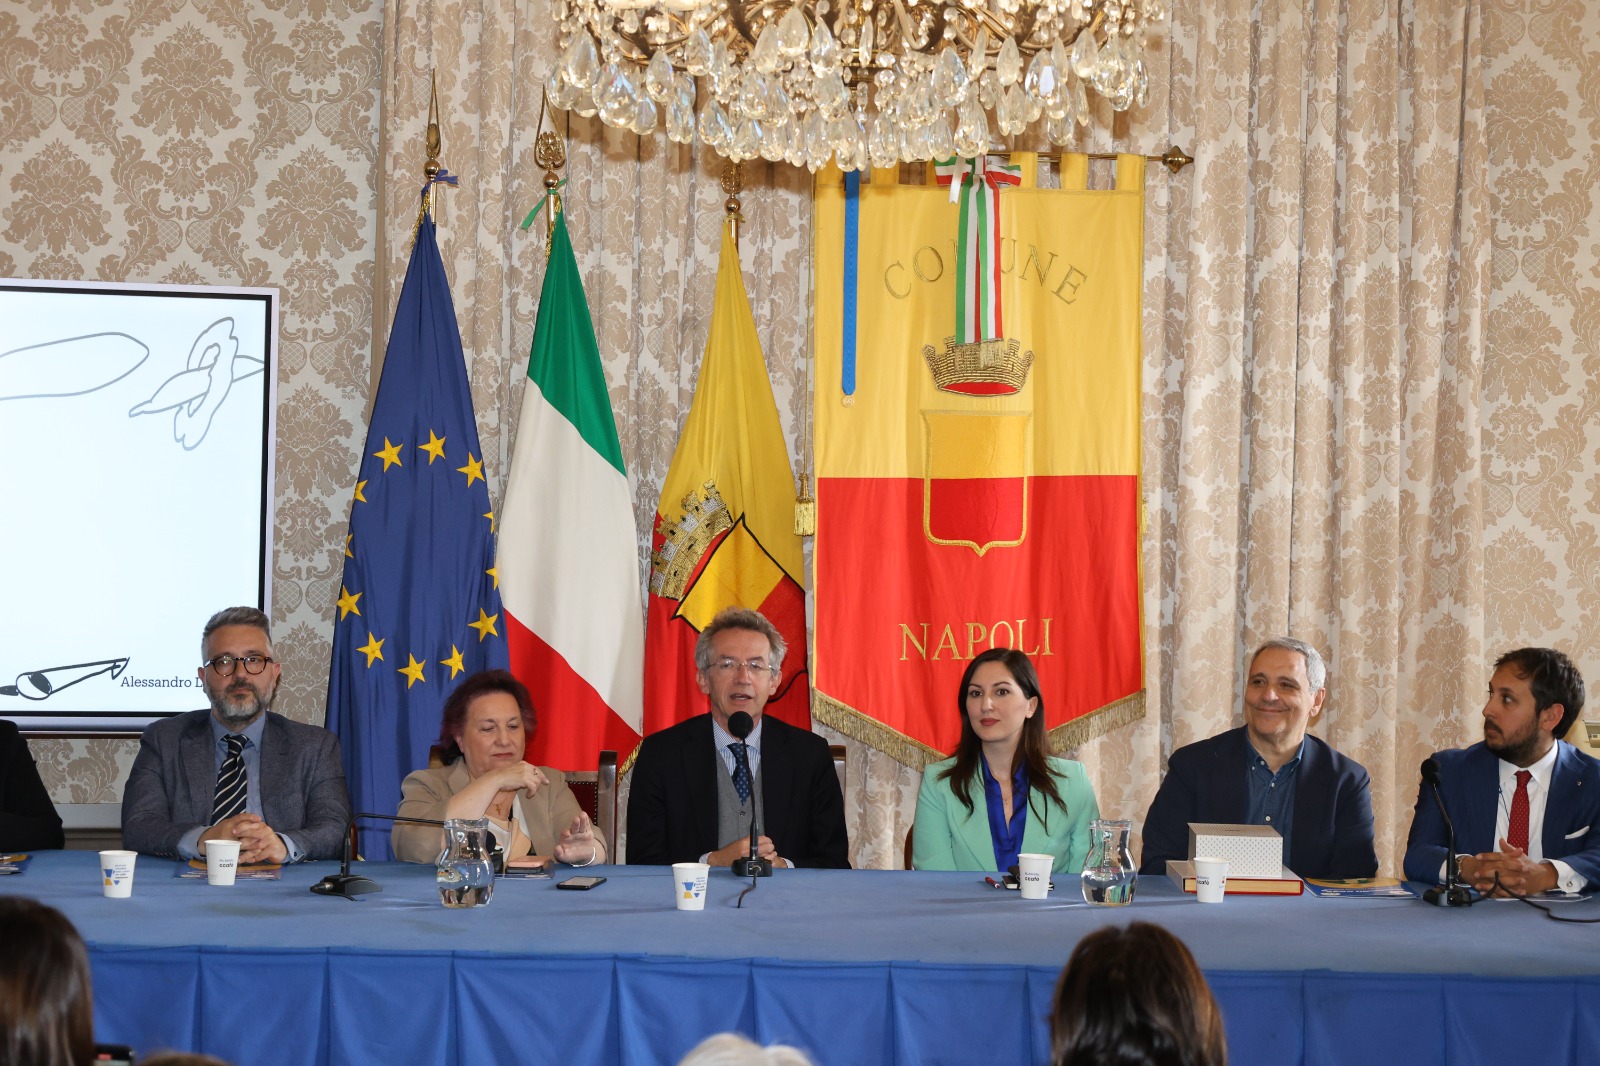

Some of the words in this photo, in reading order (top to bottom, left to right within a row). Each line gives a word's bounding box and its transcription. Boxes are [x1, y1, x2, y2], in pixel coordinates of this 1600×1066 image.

[884, 237, 1088, 305] COUNE
[898, 618, 1054, 660] NAPOLI
[120, 675, 192, 688] Alessandro
